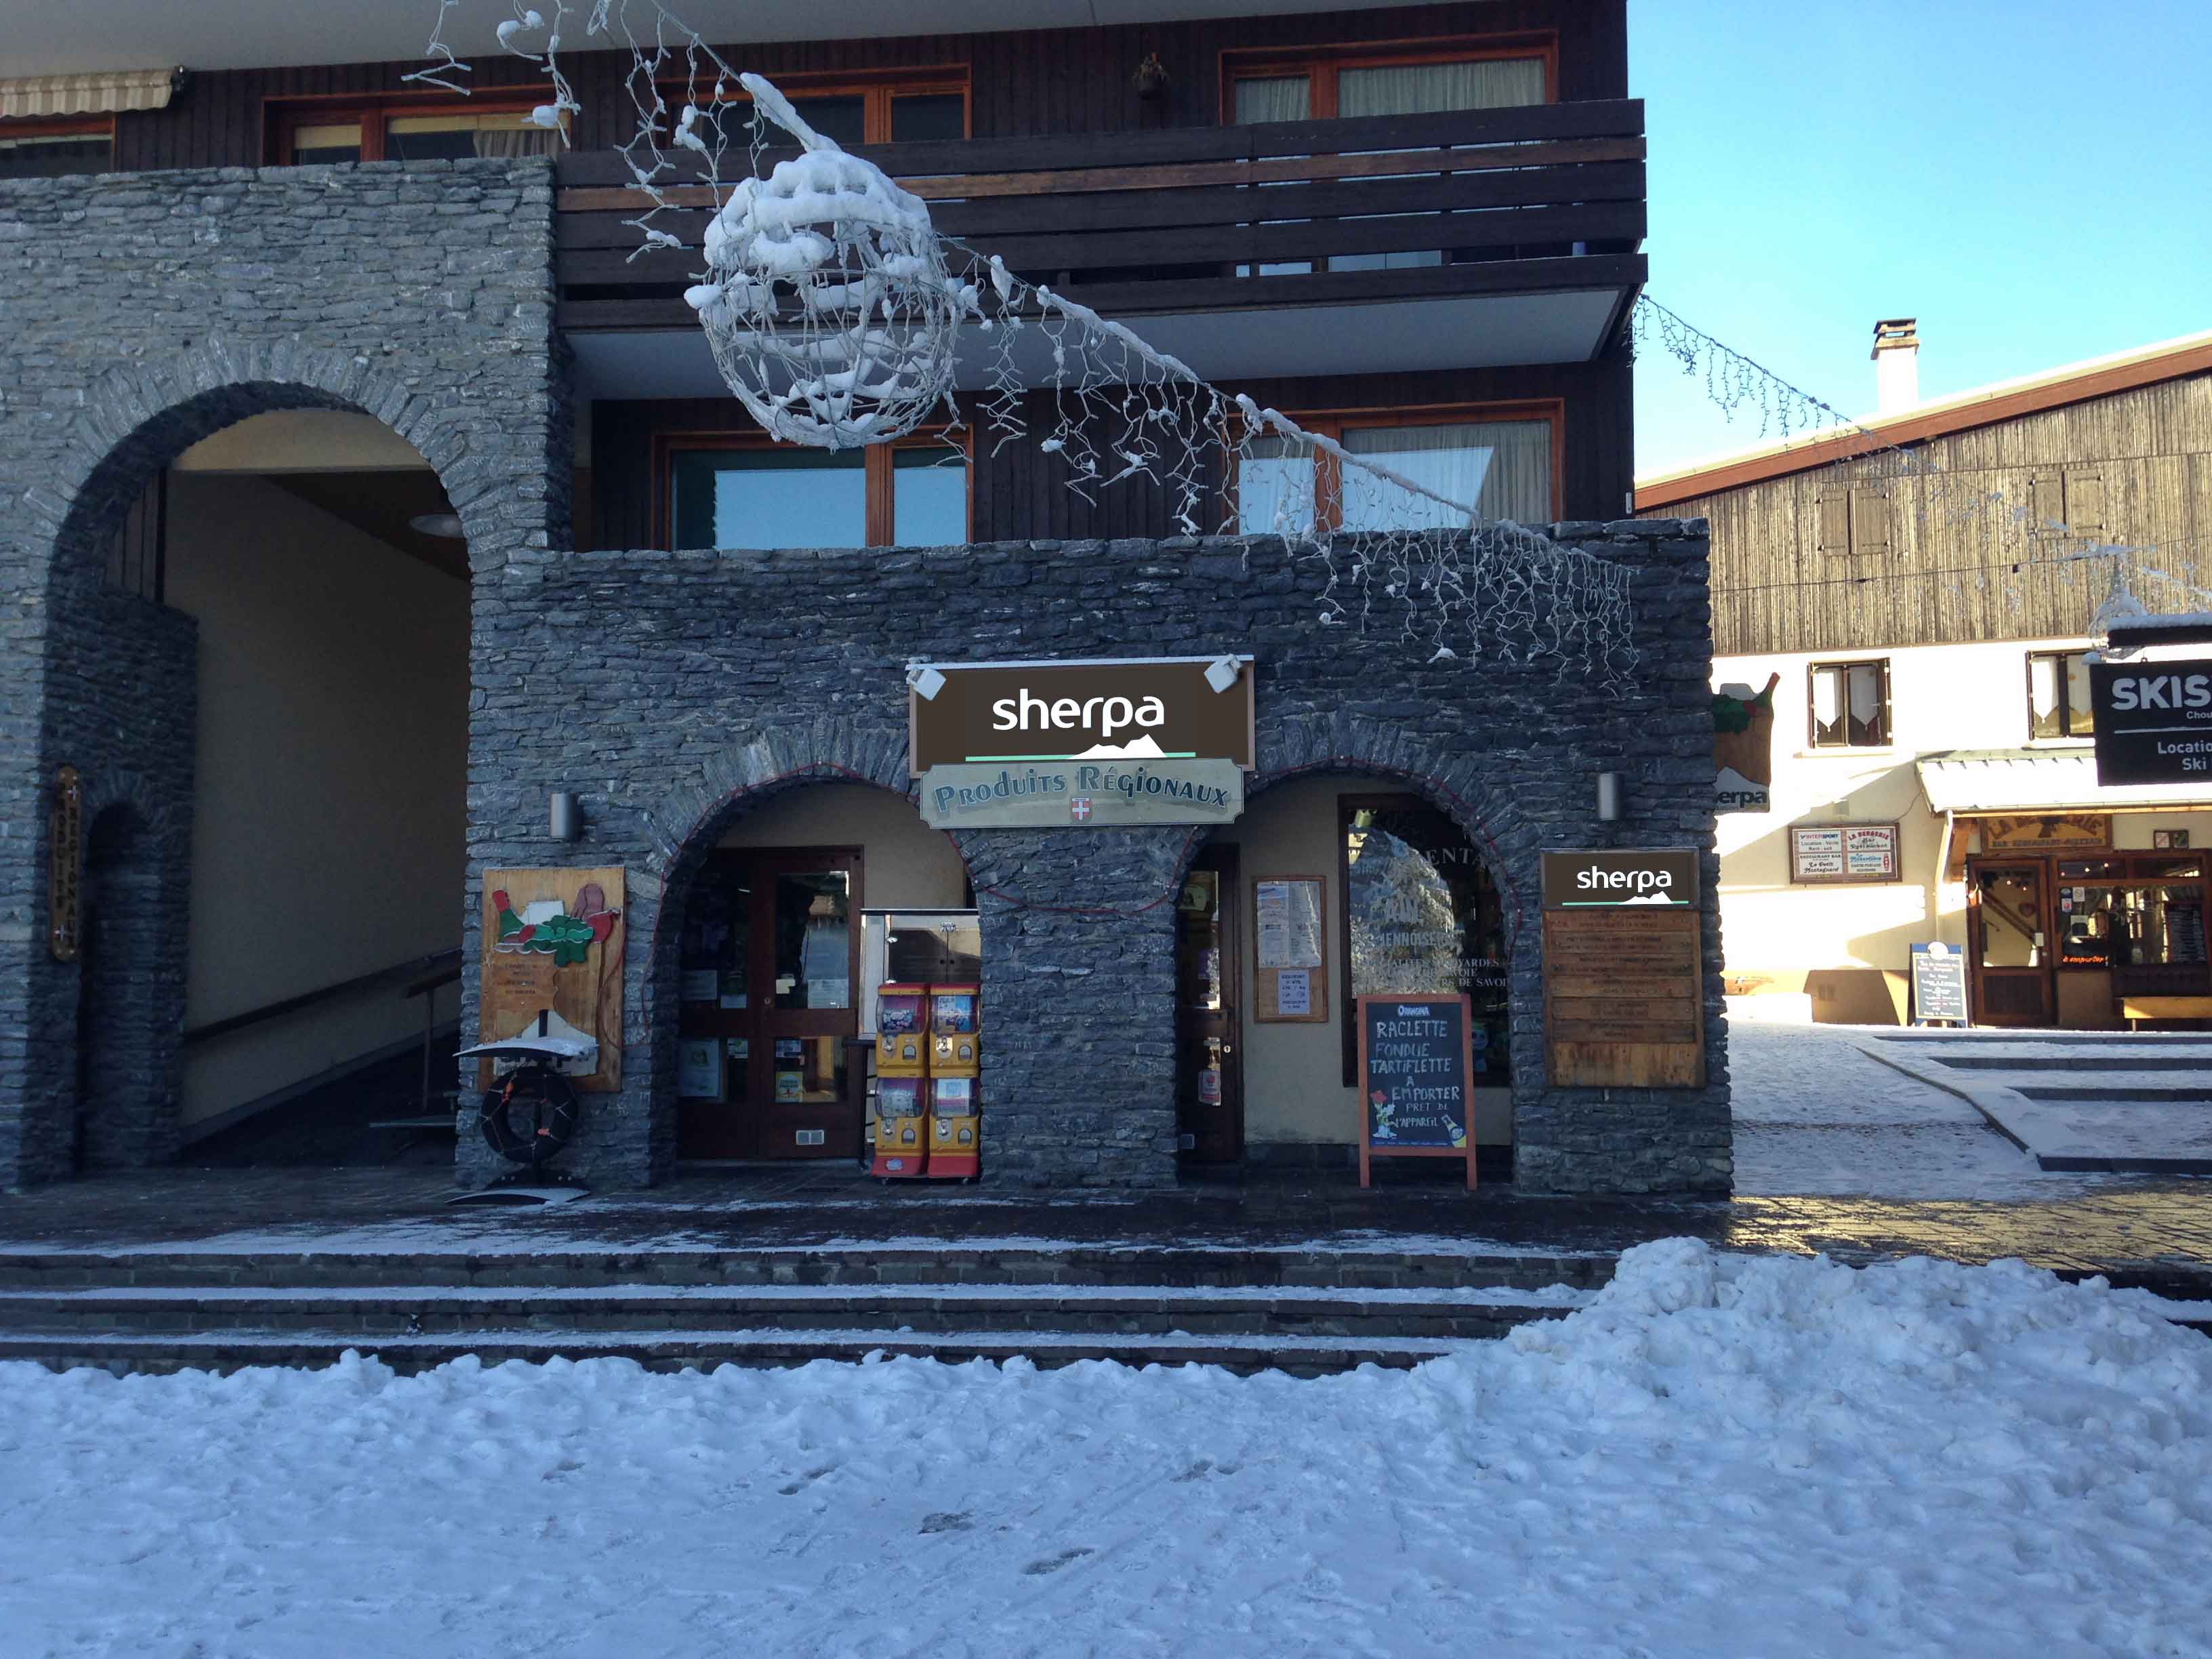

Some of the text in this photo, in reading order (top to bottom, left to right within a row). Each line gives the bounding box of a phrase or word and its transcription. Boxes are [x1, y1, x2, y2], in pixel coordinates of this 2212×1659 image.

[2111, 674, 2212, 710] SKIS
[992, 689, 1164, 737] sherpa
[2182, 757, 2207, 771] Ski
[1577, 866, 1672, 893] sherpa
[1376, 1019, 1448, 1038] RACLETTE
[1375, 1042, 1431, 1057] FONDUE
